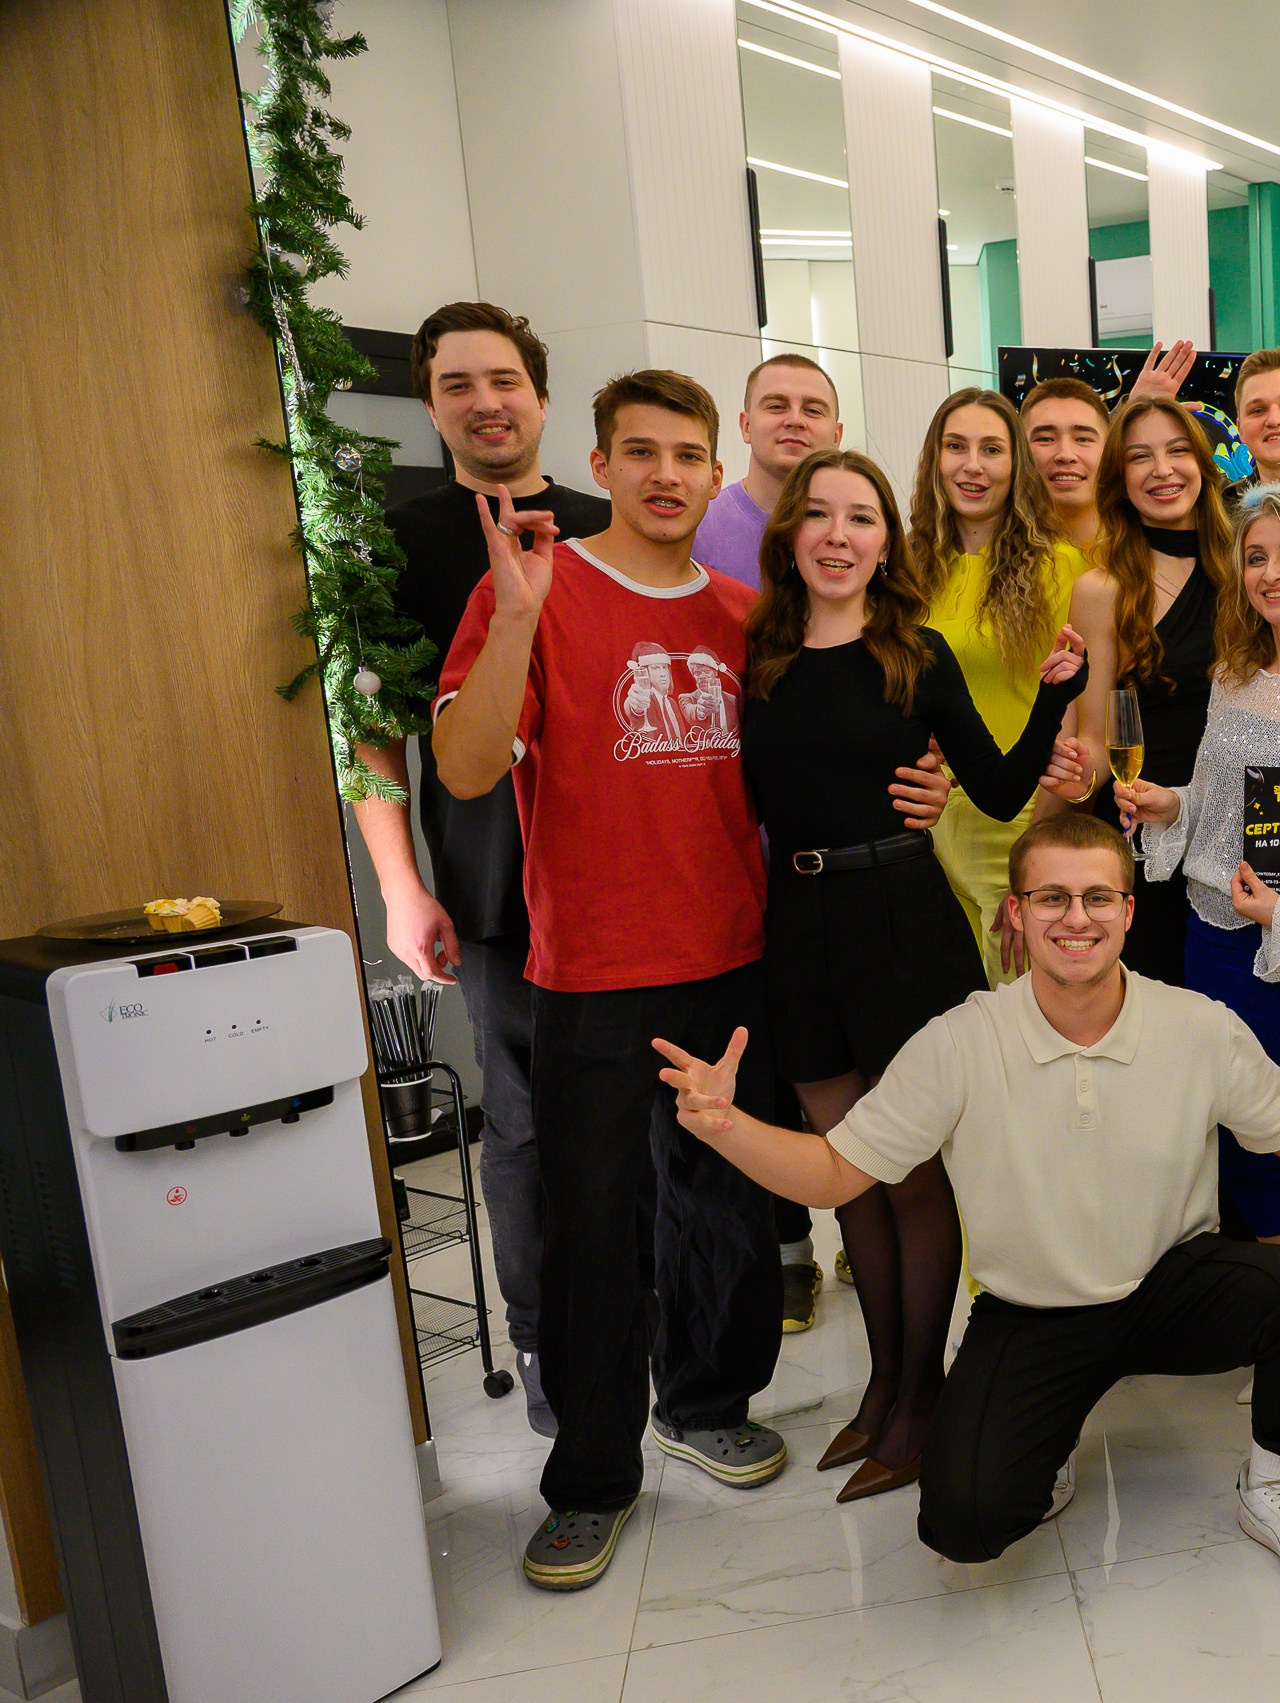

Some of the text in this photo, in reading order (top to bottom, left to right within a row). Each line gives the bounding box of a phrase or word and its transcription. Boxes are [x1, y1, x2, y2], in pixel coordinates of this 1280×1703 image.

[613, 731, 680, 762] Badass
[1255, 839, 1268, 848] НА
[119, 1002, 143, 1015] ECO
[121, 1009, 150, 1020] TRONIC
[251, 1025, 270, 1034] EMPTY
[228, 1031, 244, 1039] COLD
